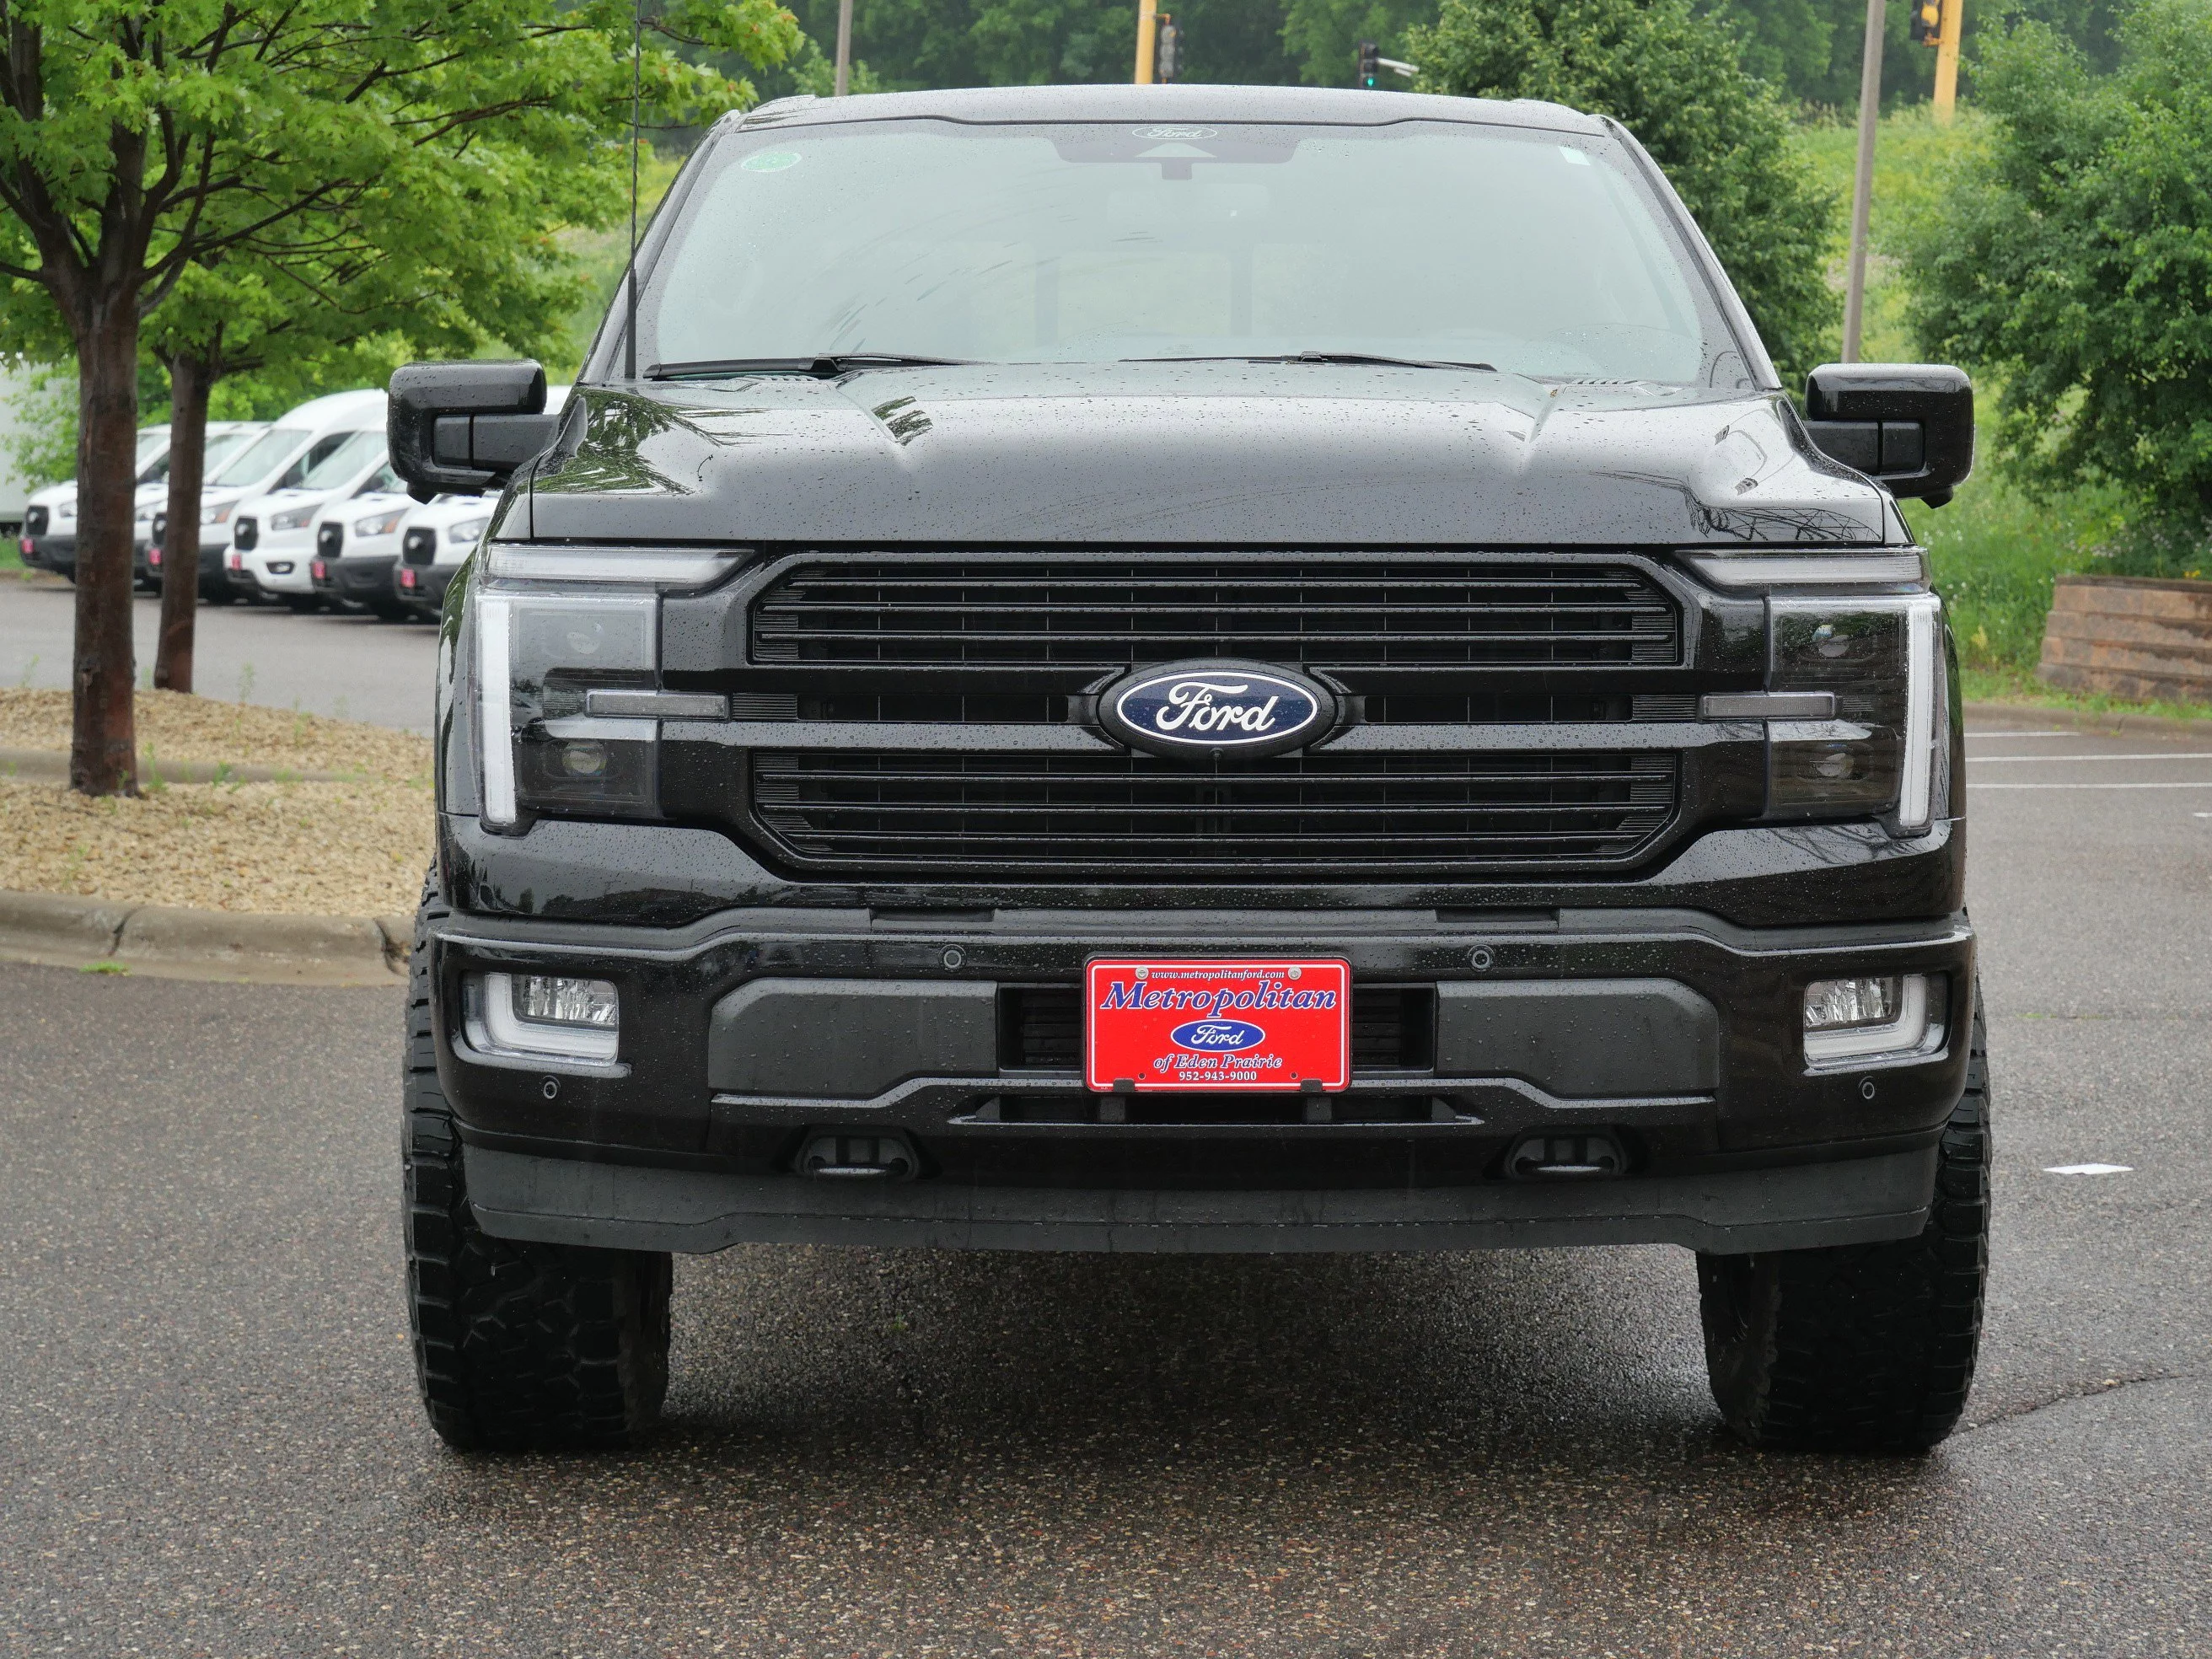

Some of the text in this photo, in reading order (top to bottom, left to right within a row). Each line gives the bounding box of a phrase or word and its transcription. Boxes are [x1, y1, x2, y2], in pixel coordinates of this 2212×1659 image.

[1146, 126, 1203, 137] Ford
[1156, 681, 1280, 731] Ford
[1151, 969, 1285, 981] www.metropolitanford.com
[1100, 980, 1337, 1018] Metropolitan
[1190, 1023, 1244, 1045] Ford
[1153, 1053, 1283, 1073] of Eden Prairie
[1178, 1071, 1258, 1082] 952-943-9000
